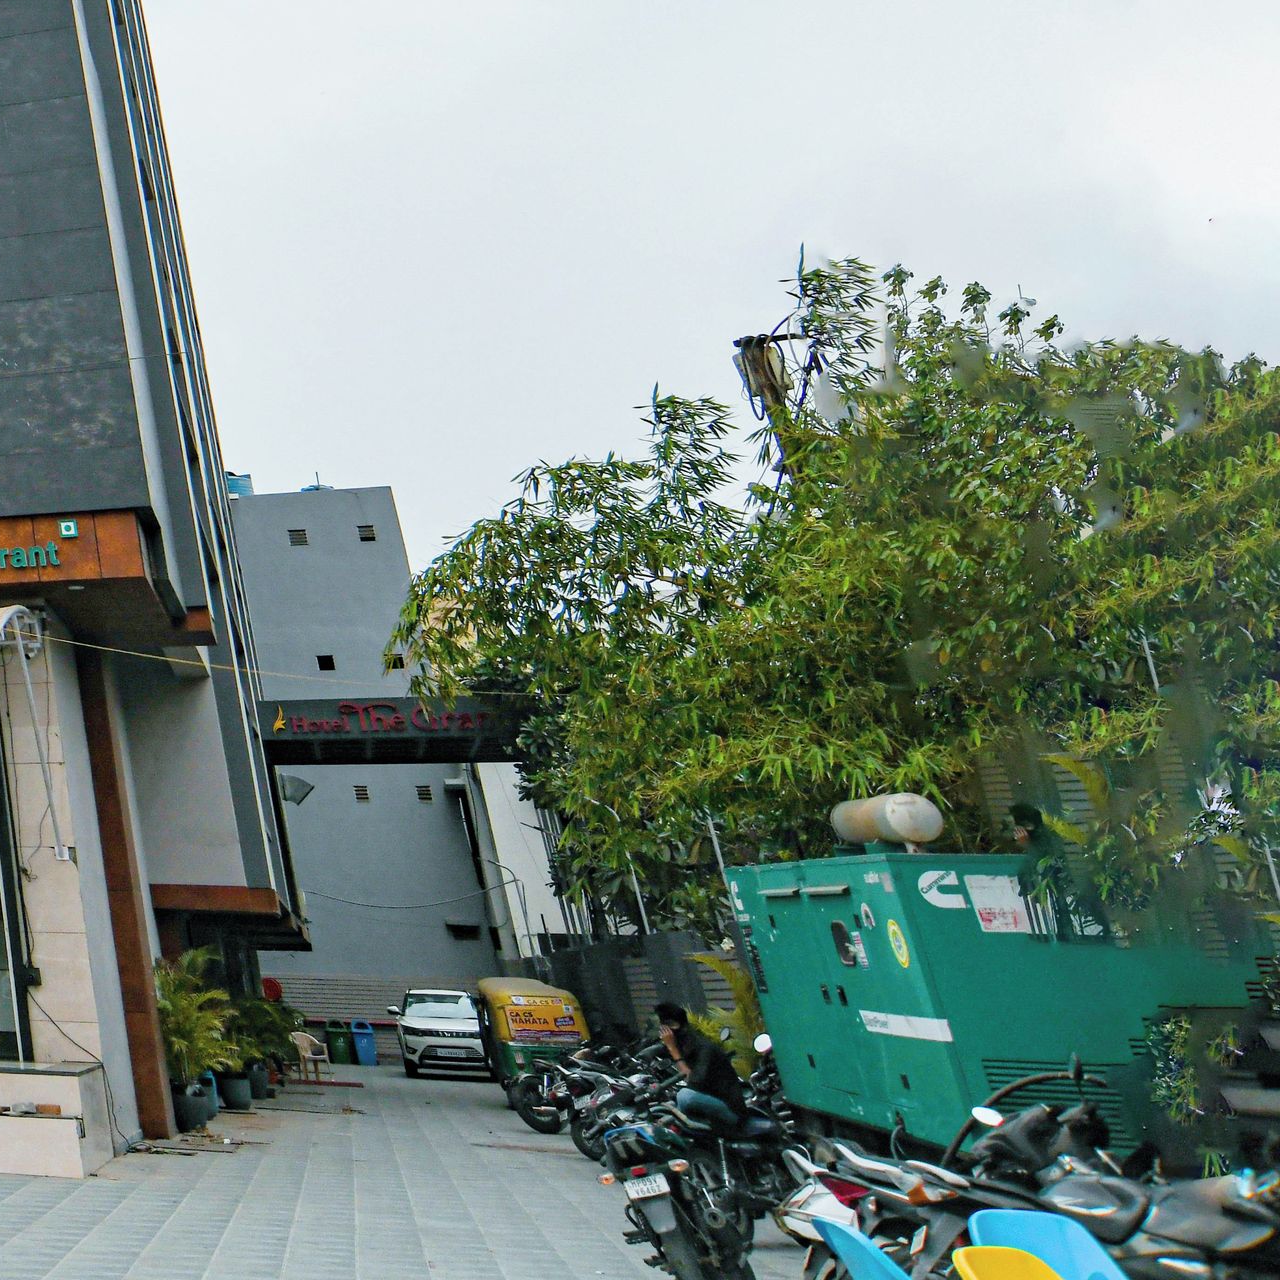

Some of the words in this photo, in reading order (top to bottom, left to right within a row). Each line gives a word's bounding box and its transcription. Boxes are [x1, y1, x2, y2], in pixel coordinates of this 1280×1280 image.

[290, 714, 350, 733] Hotel
[340, 700, 407, 732] The
[921, 870, 952, 894] Cummins
